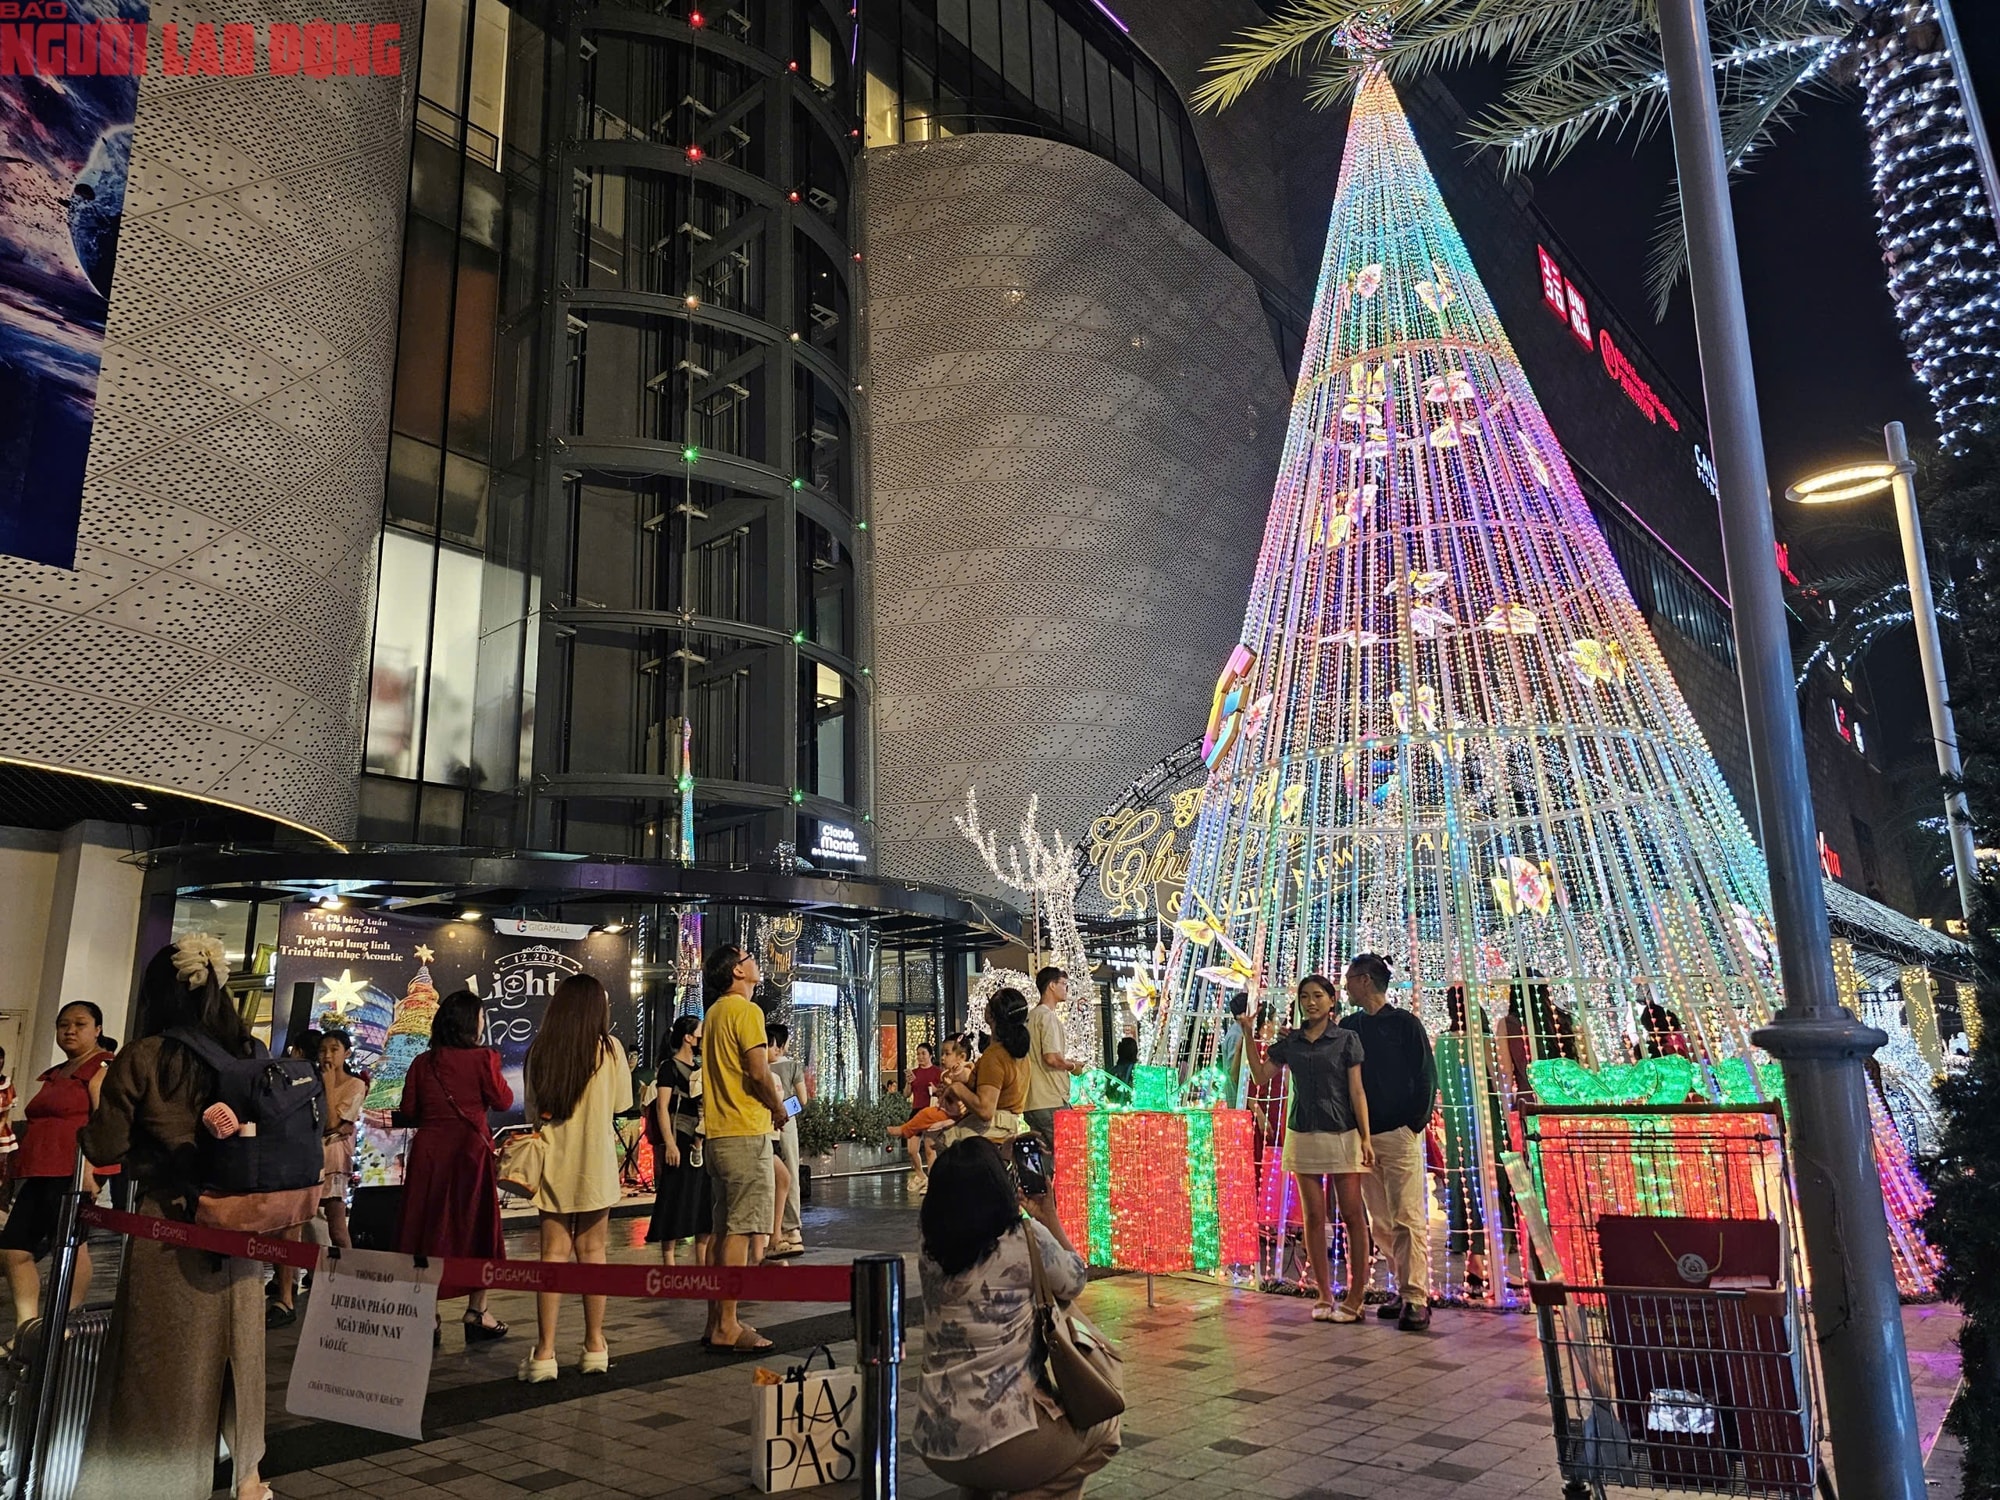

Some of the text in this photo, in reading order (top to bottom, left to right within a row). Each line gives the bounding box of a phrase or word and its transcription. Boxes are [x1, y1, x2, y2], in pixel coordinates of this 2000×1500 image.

[1567, 286, 1586, 319] UNI
[1571, 309, 1591, 341] QLO
[822, 824, 855, 841] Claude
[820, 836, 860, 854] Monet
[303, 912, 316, 921] T7
[325, 914, 341, 923] CN
[326, 922, 343, 932] 19h
[362, 926, 379, 935] 21h
[529, 924, 569, 934] GIGAMALL
[280, 945, 311, 956] Trình
[336, 949, 361, 961] nhạc
[361, 950, 404, 962] Acoustic
[346, 939, 369, 951] lung
[370, 941, 391, 950] linh
[513, 952, 564, 965] 12.2025
[256, 1247, 288, 1259] GIGAMALL
[494, 1268, 542, 1283] GIGAMALL
[662, 1274, 720, 1291] GIGAMALL
[330, 1293, 350, 1310] LỊCH
[367, 1298, 395, 1315] PHÁO
[397, 1303, 418, 1318] HOA
[381, 1324, 404, 1340] NAY
[777, 1379, 843, 1436] HA
[766, 1428, 856, 1492] PAS
